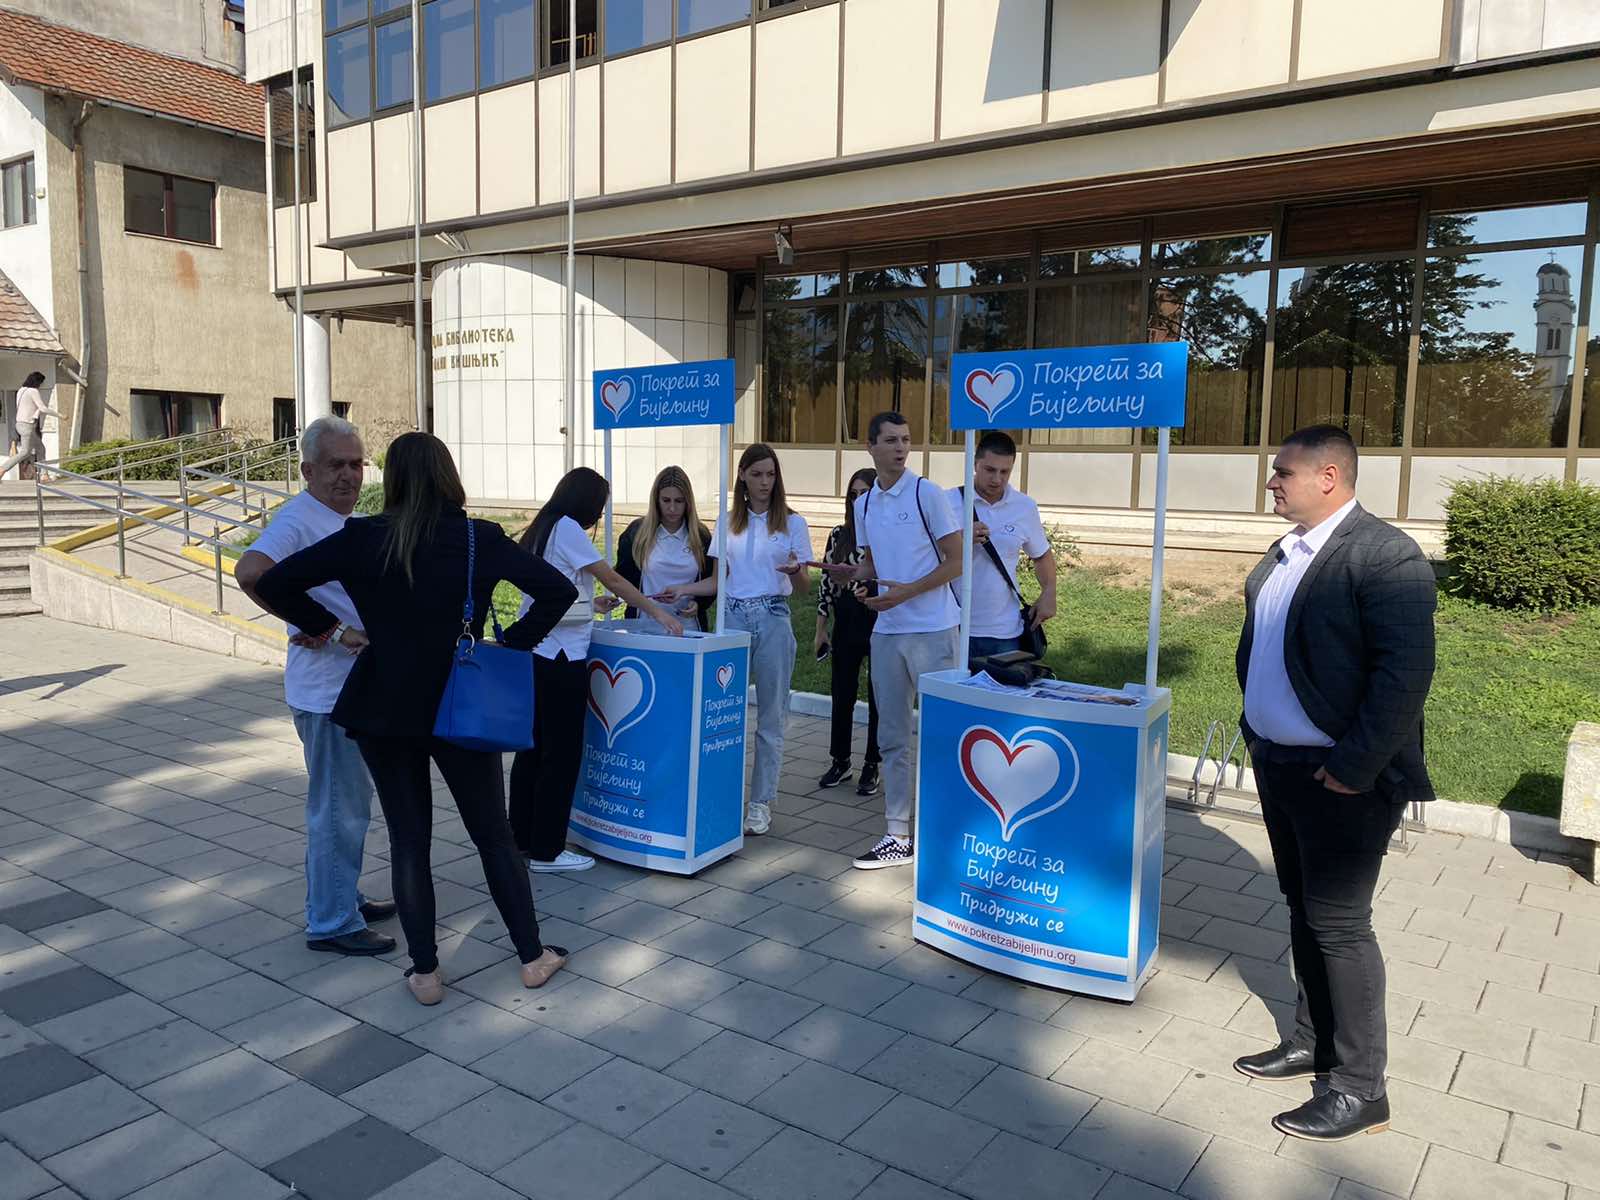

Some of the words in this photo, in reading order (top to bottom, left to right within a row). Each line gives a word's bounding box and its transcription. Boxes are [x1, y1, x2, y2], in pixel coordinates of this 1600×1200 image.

[446, 328, 515, 346] БИБЛИОТЕКА
[641, 370, 699, 397] Покрет
[703, 373, 720, 388] за
[1033, 358, 1129, 391] Покрет
[1135, 361, 1163, 381] за
[640, 396, 710, 421] Бијељину
[1029, 391, 1145, 423] Бијељину
[585, 744, 629, 770] Покрет
[631, 759, 646, 773] за
[587, 765, 642, 795] Бијељину
[583, 791, 630, 815] Придружи
[632, 808, 646, 819] се
[962, 832, 1037, 869] Покрет
[1041, 856, 1065, 875] за
[967, 859, 1059, 904] Бијељину
[960, 891, 1039, 928] Придружи
[1045, 919, 1065, 933] се
[946, 918, 1077, 965] www.pokretzabijeljinu.org
